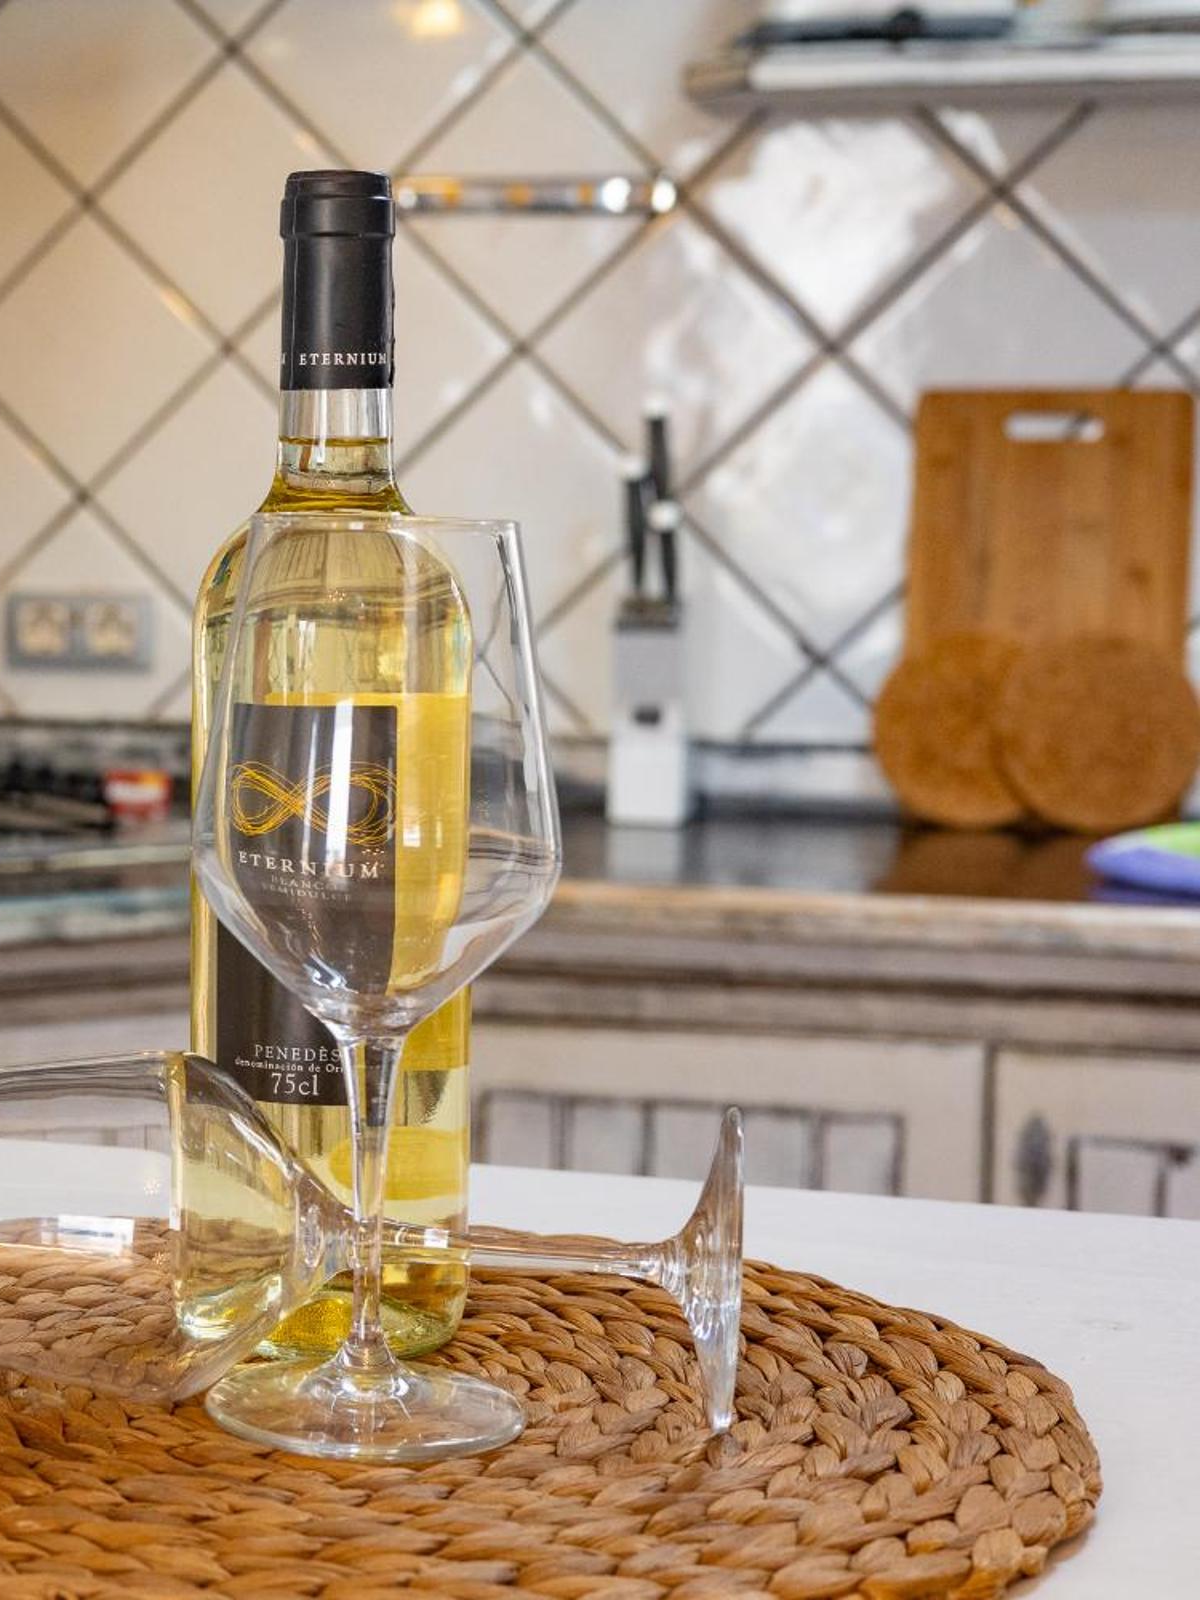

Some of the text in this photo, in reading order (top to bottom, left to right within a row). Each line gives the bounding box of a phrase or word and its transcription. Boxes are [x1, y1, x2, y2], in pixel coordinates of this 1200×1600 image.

[238, 850, 379, 879] ETERNIUM
[308, 1063, 321, 1073] de
[271, 1072, 320, 1096] 75cl
